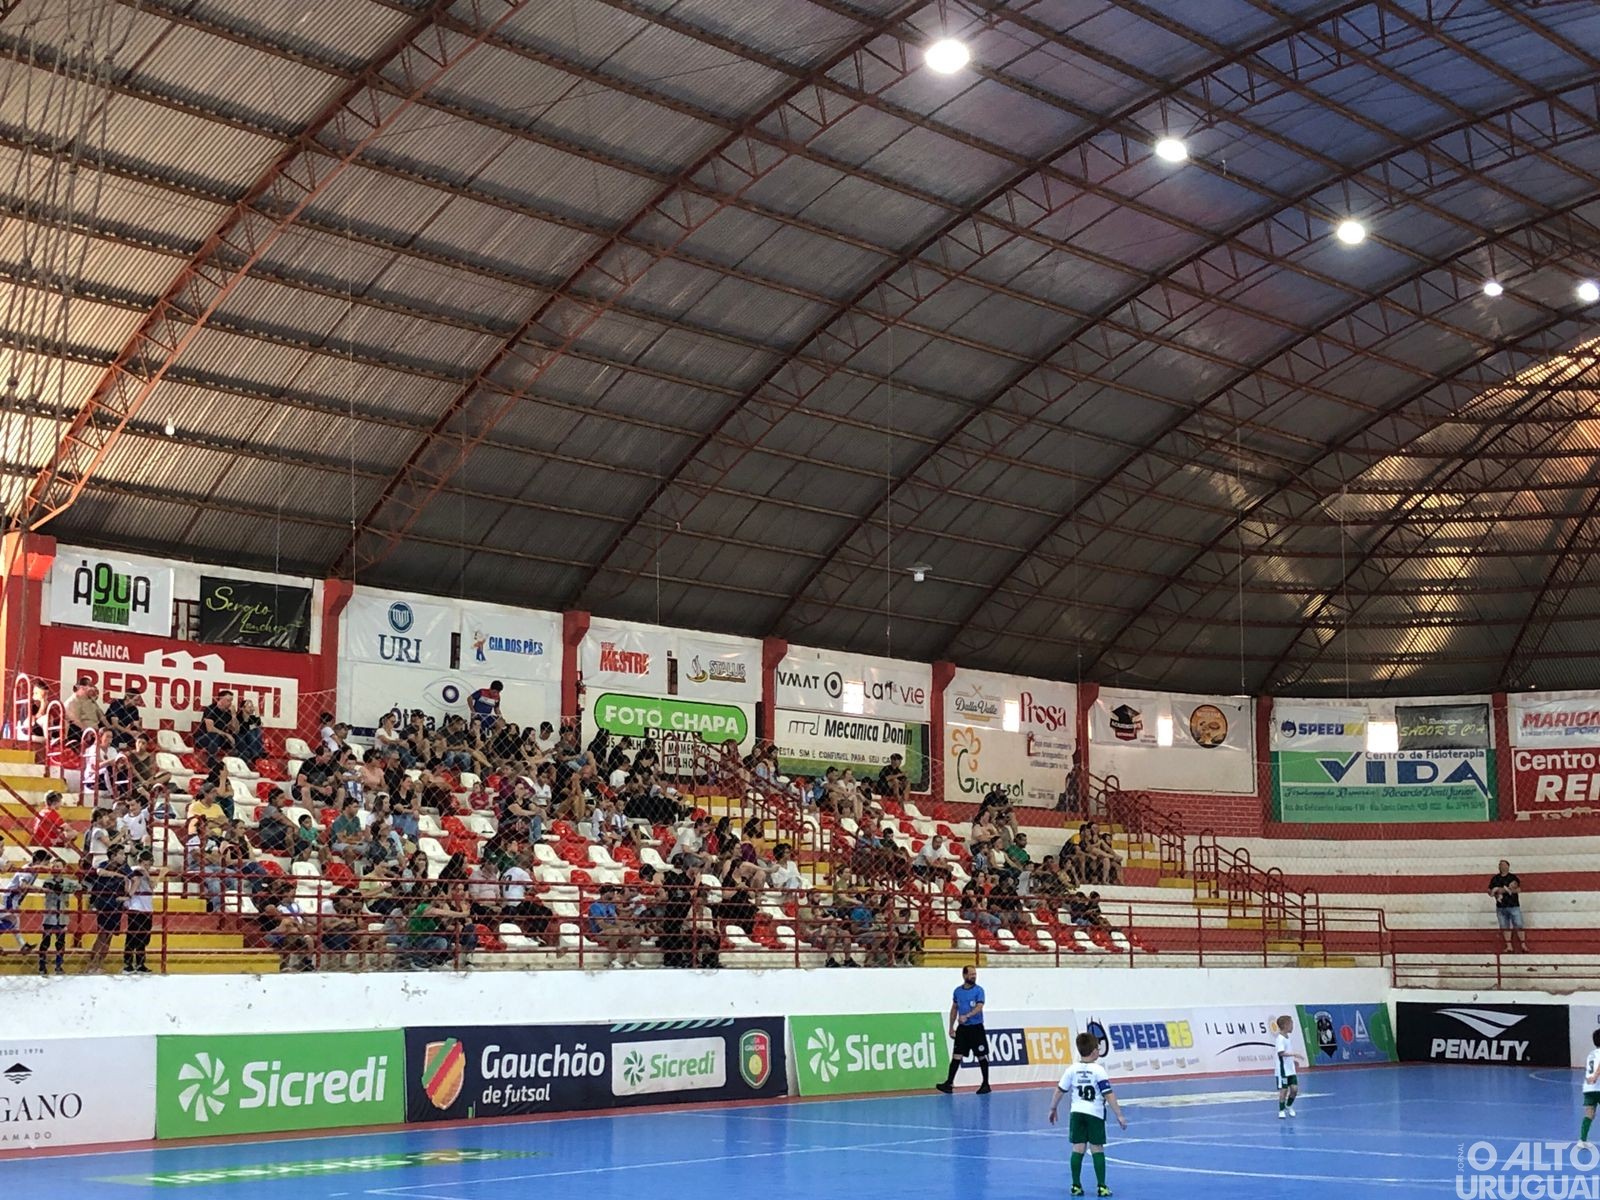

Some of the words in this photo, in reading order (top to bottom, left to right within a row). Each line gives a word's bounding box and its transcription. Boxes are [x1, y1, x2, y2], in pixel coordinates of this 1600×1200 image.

[204, 586, 272, 622] Sergio
[72, 639, 131, 661] MECÂNICA
[378, 634, 422, 663] URI
[489, 636, 504, 651] CIA
[505, 638, 522, 653] DOS
[523, 638, 543, 656] PÃES
[604, 704, 663, 728] FOTO
[670, 711, 740, 735] CHAPA
[1020, 691, 1067, 732] Prosa
[1365, 750, 1405, 760] Centro
[1409, 750, 1423, 760] de
[1516, 749, 1596, 772] Centro
[1318, 752, 1490, 798] VIDA
[481, 1043, 606, 1080] Gauchão
[845, 1032, 937, 1073] Sicredi
[1430, 1038, 1529, 1061] PENALTY
[649, 1051, 716, 1079] Sicredi
[239, 1055, 388, 1109] Sicredi
[482, 1085, 502, 1104] de
[502, 1083, 551, 1108] futsal
